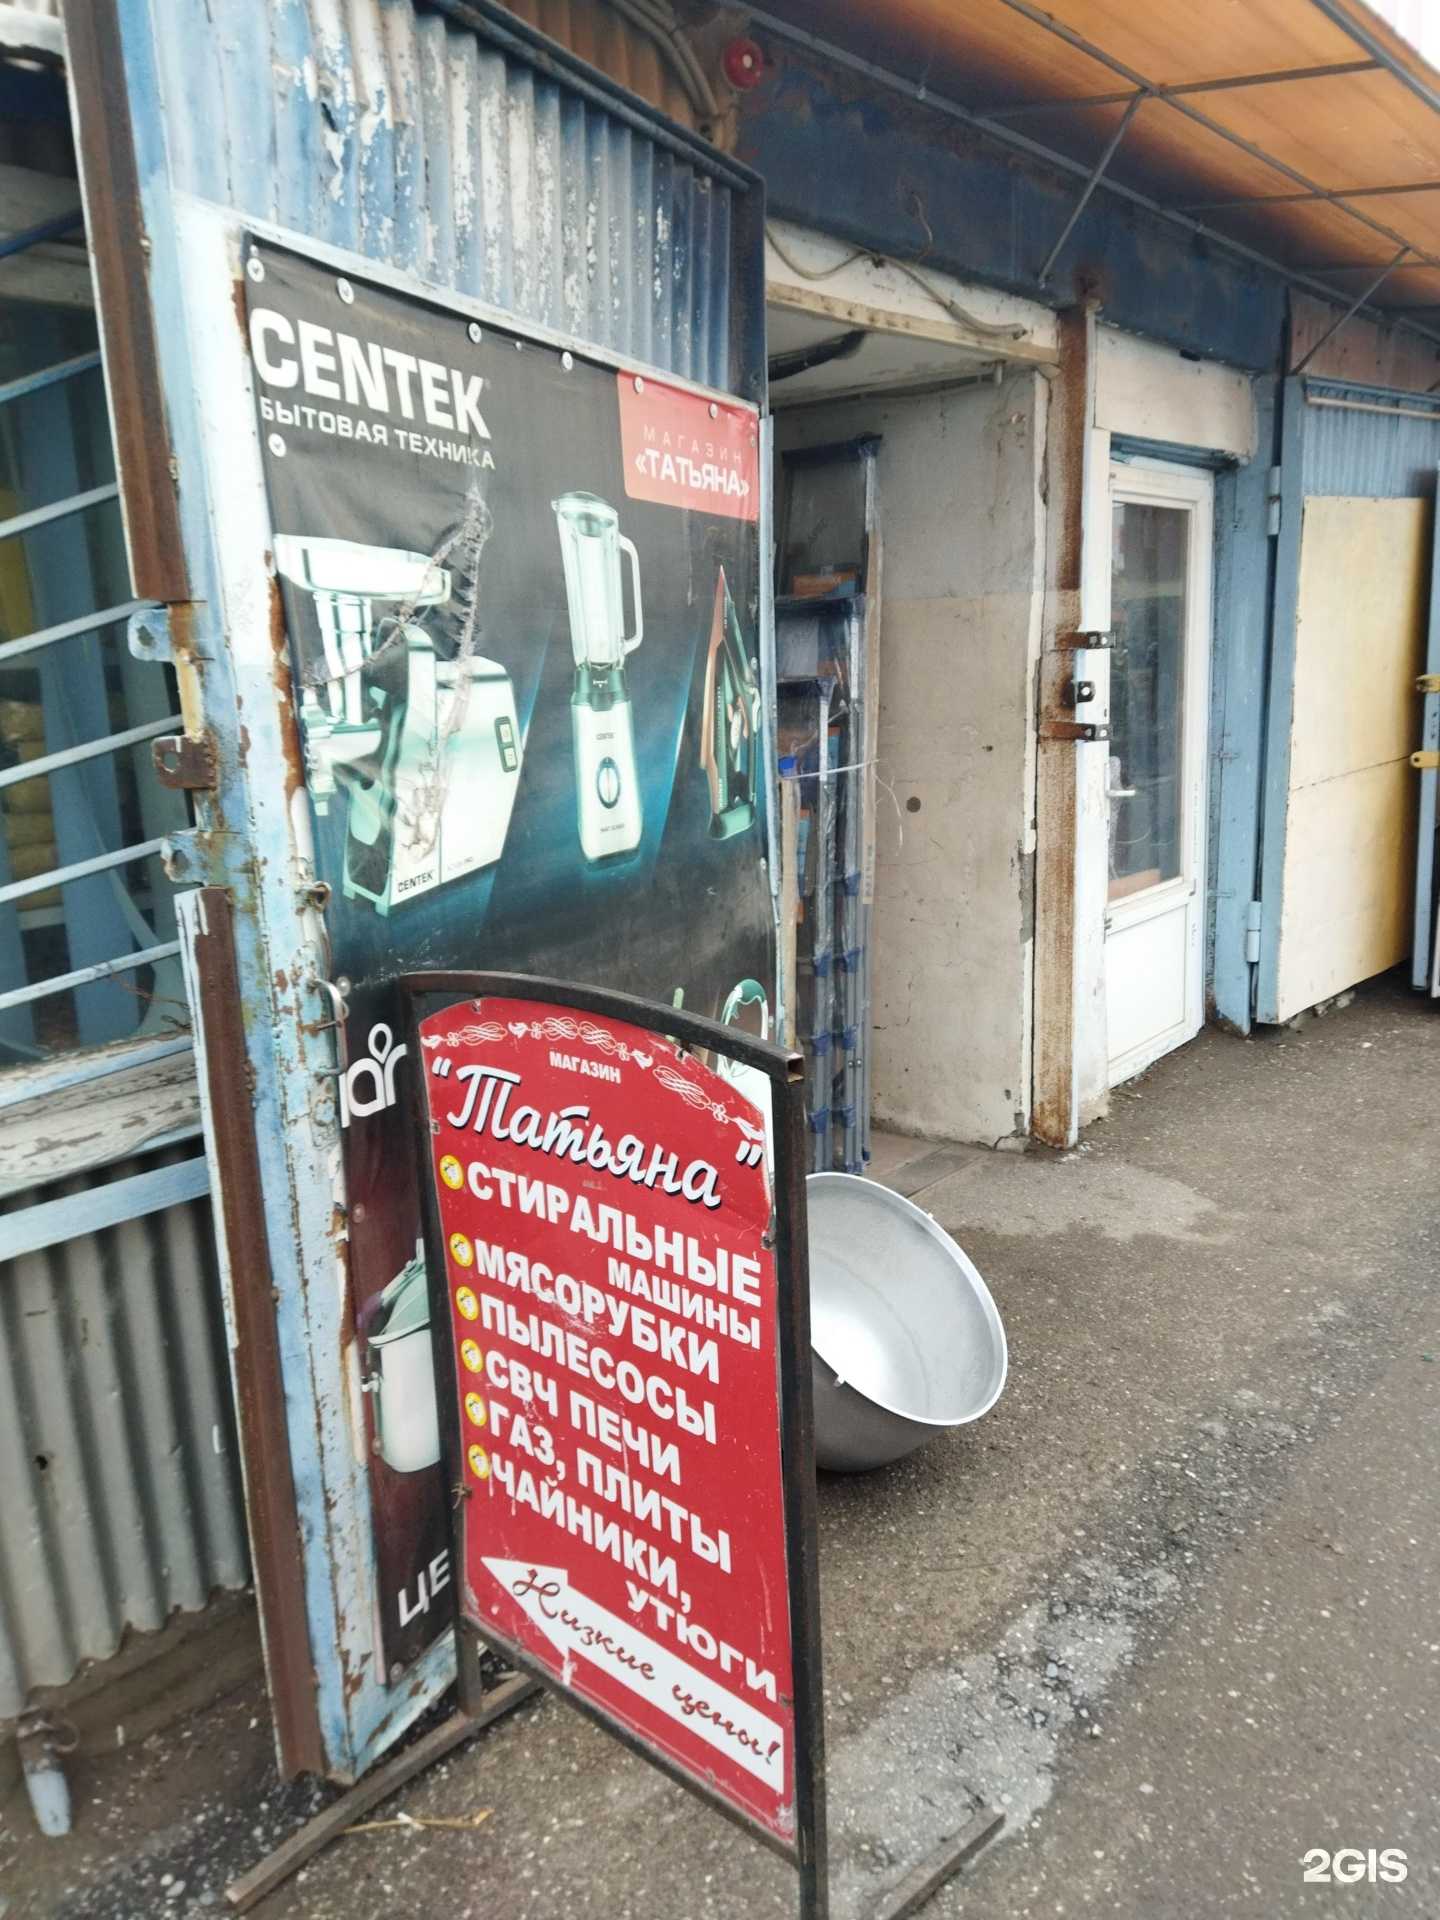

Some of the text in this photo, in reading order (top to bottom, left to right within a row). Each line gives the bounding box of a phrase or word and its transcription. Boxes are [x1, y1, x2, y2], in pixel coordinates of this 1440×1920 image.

[250, 307, 491, 439] CENTEK
[260, 396, 495, 469] БЫТОВАЯ ТЕХНИКА
[634, 447, 750, 497] «ТАТЬЯНА»
[643, 424, 742, 462] МАГАЗИН
[398, 870, 433, 893] CENTEK
[549, 1051, 621, 1083] МАГАЗИН
[467, 1162, 762, 1307] СТИРАЛЬНЫЕ
[474, 1239, 720, 1384] МЯСОРУБКИ
[481, 1294, 717, 1444] ПЫЛЕСОСЫ
[608, 1257, 761, 1350] МАШИНЫ
[486, 1350, 681, 1486] СВЧ ПЕЧИ
[489, 1402, 733, 1574] ГАЗ, ПЛИТЫ
[491, 1453, 692, 1611] ЧАЙНИКИ,
[512, 1569, 781, 1764] Низкие цены!
[626, 1581, 778, 1703] УТЮГИ
